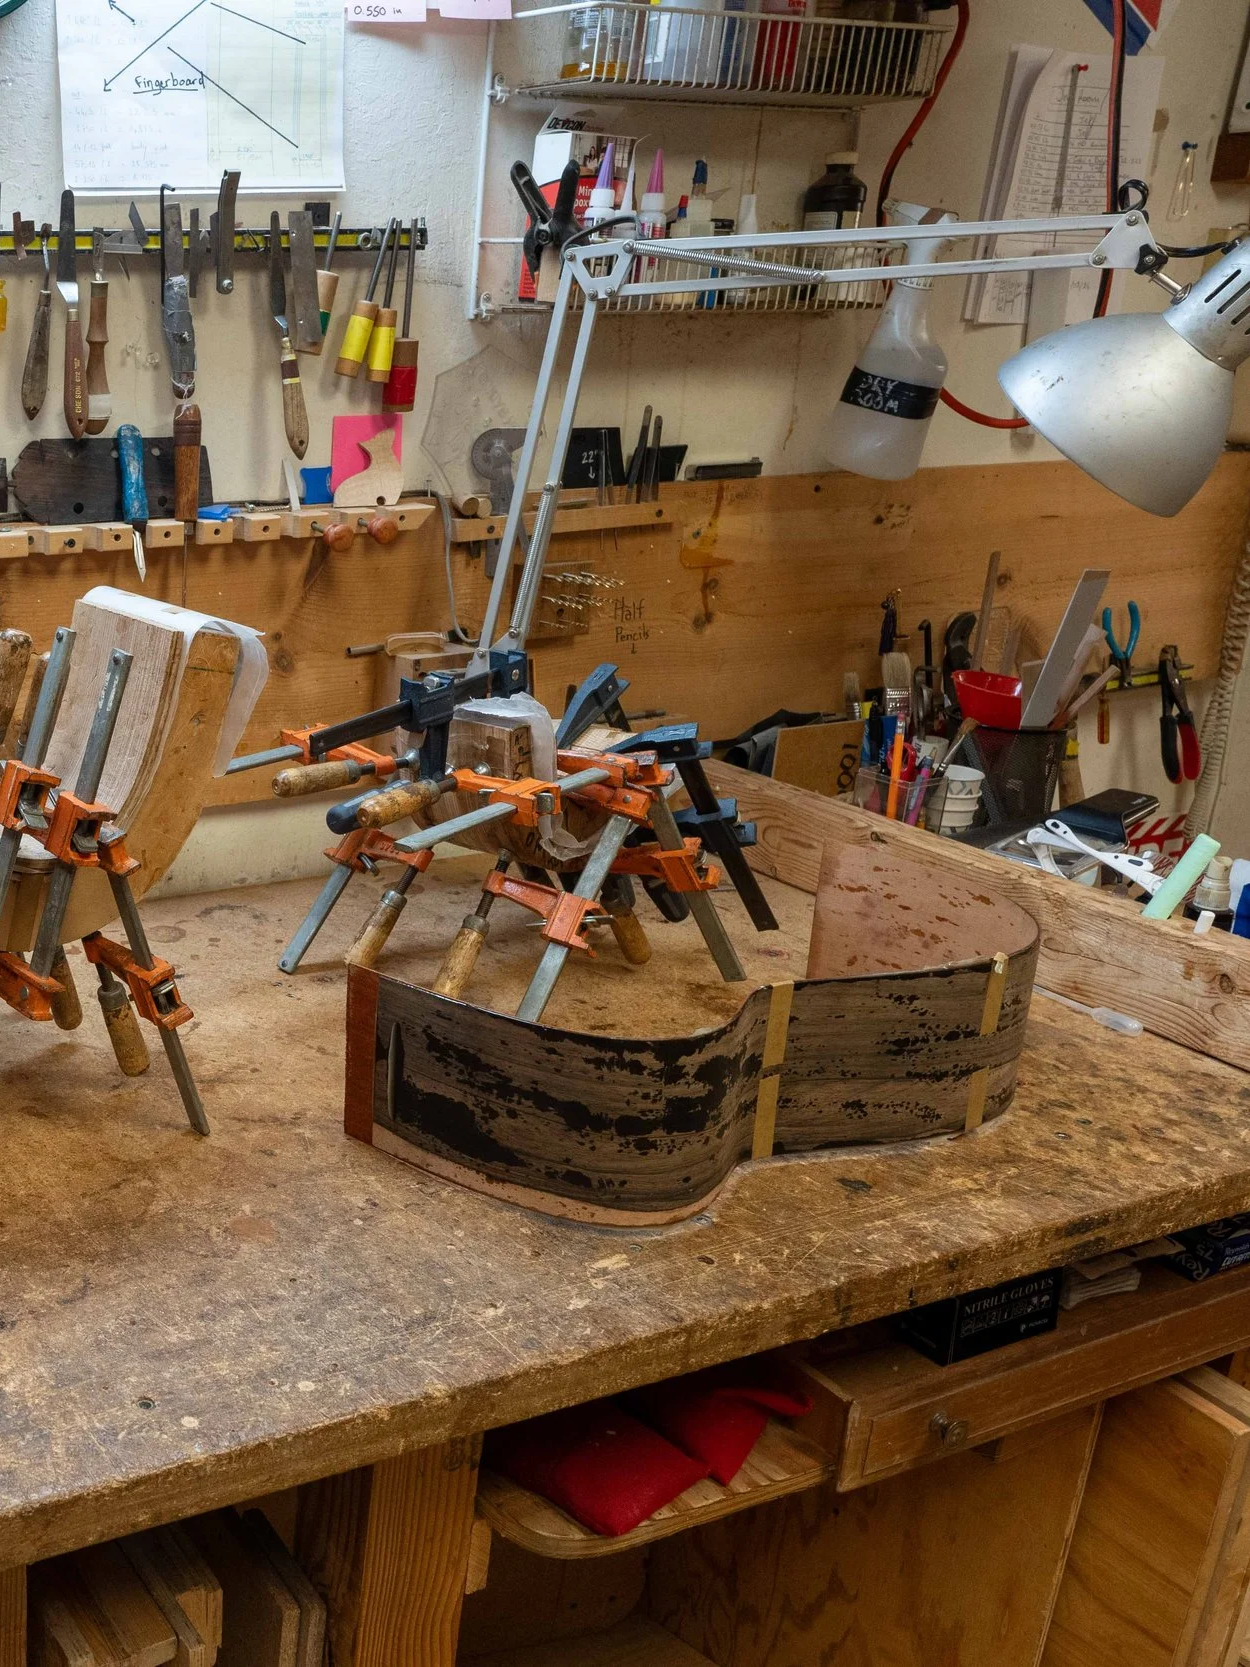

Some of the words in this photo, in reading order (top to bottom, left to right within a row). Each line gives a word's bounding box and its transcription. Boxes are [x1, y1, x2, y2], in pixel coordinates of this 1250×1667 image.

[353, 5, 387, 17] 0.550
[393, 7, 403, 15] in
[547, 117, 587, 132] DEVCON
[614, 596, 646, 622] Half
[615, 622, 650, 644] Pencils
[963, 1293, 1010, 1317] NITRILE
[1010, 1276, 1055, 1299] GLOVES
